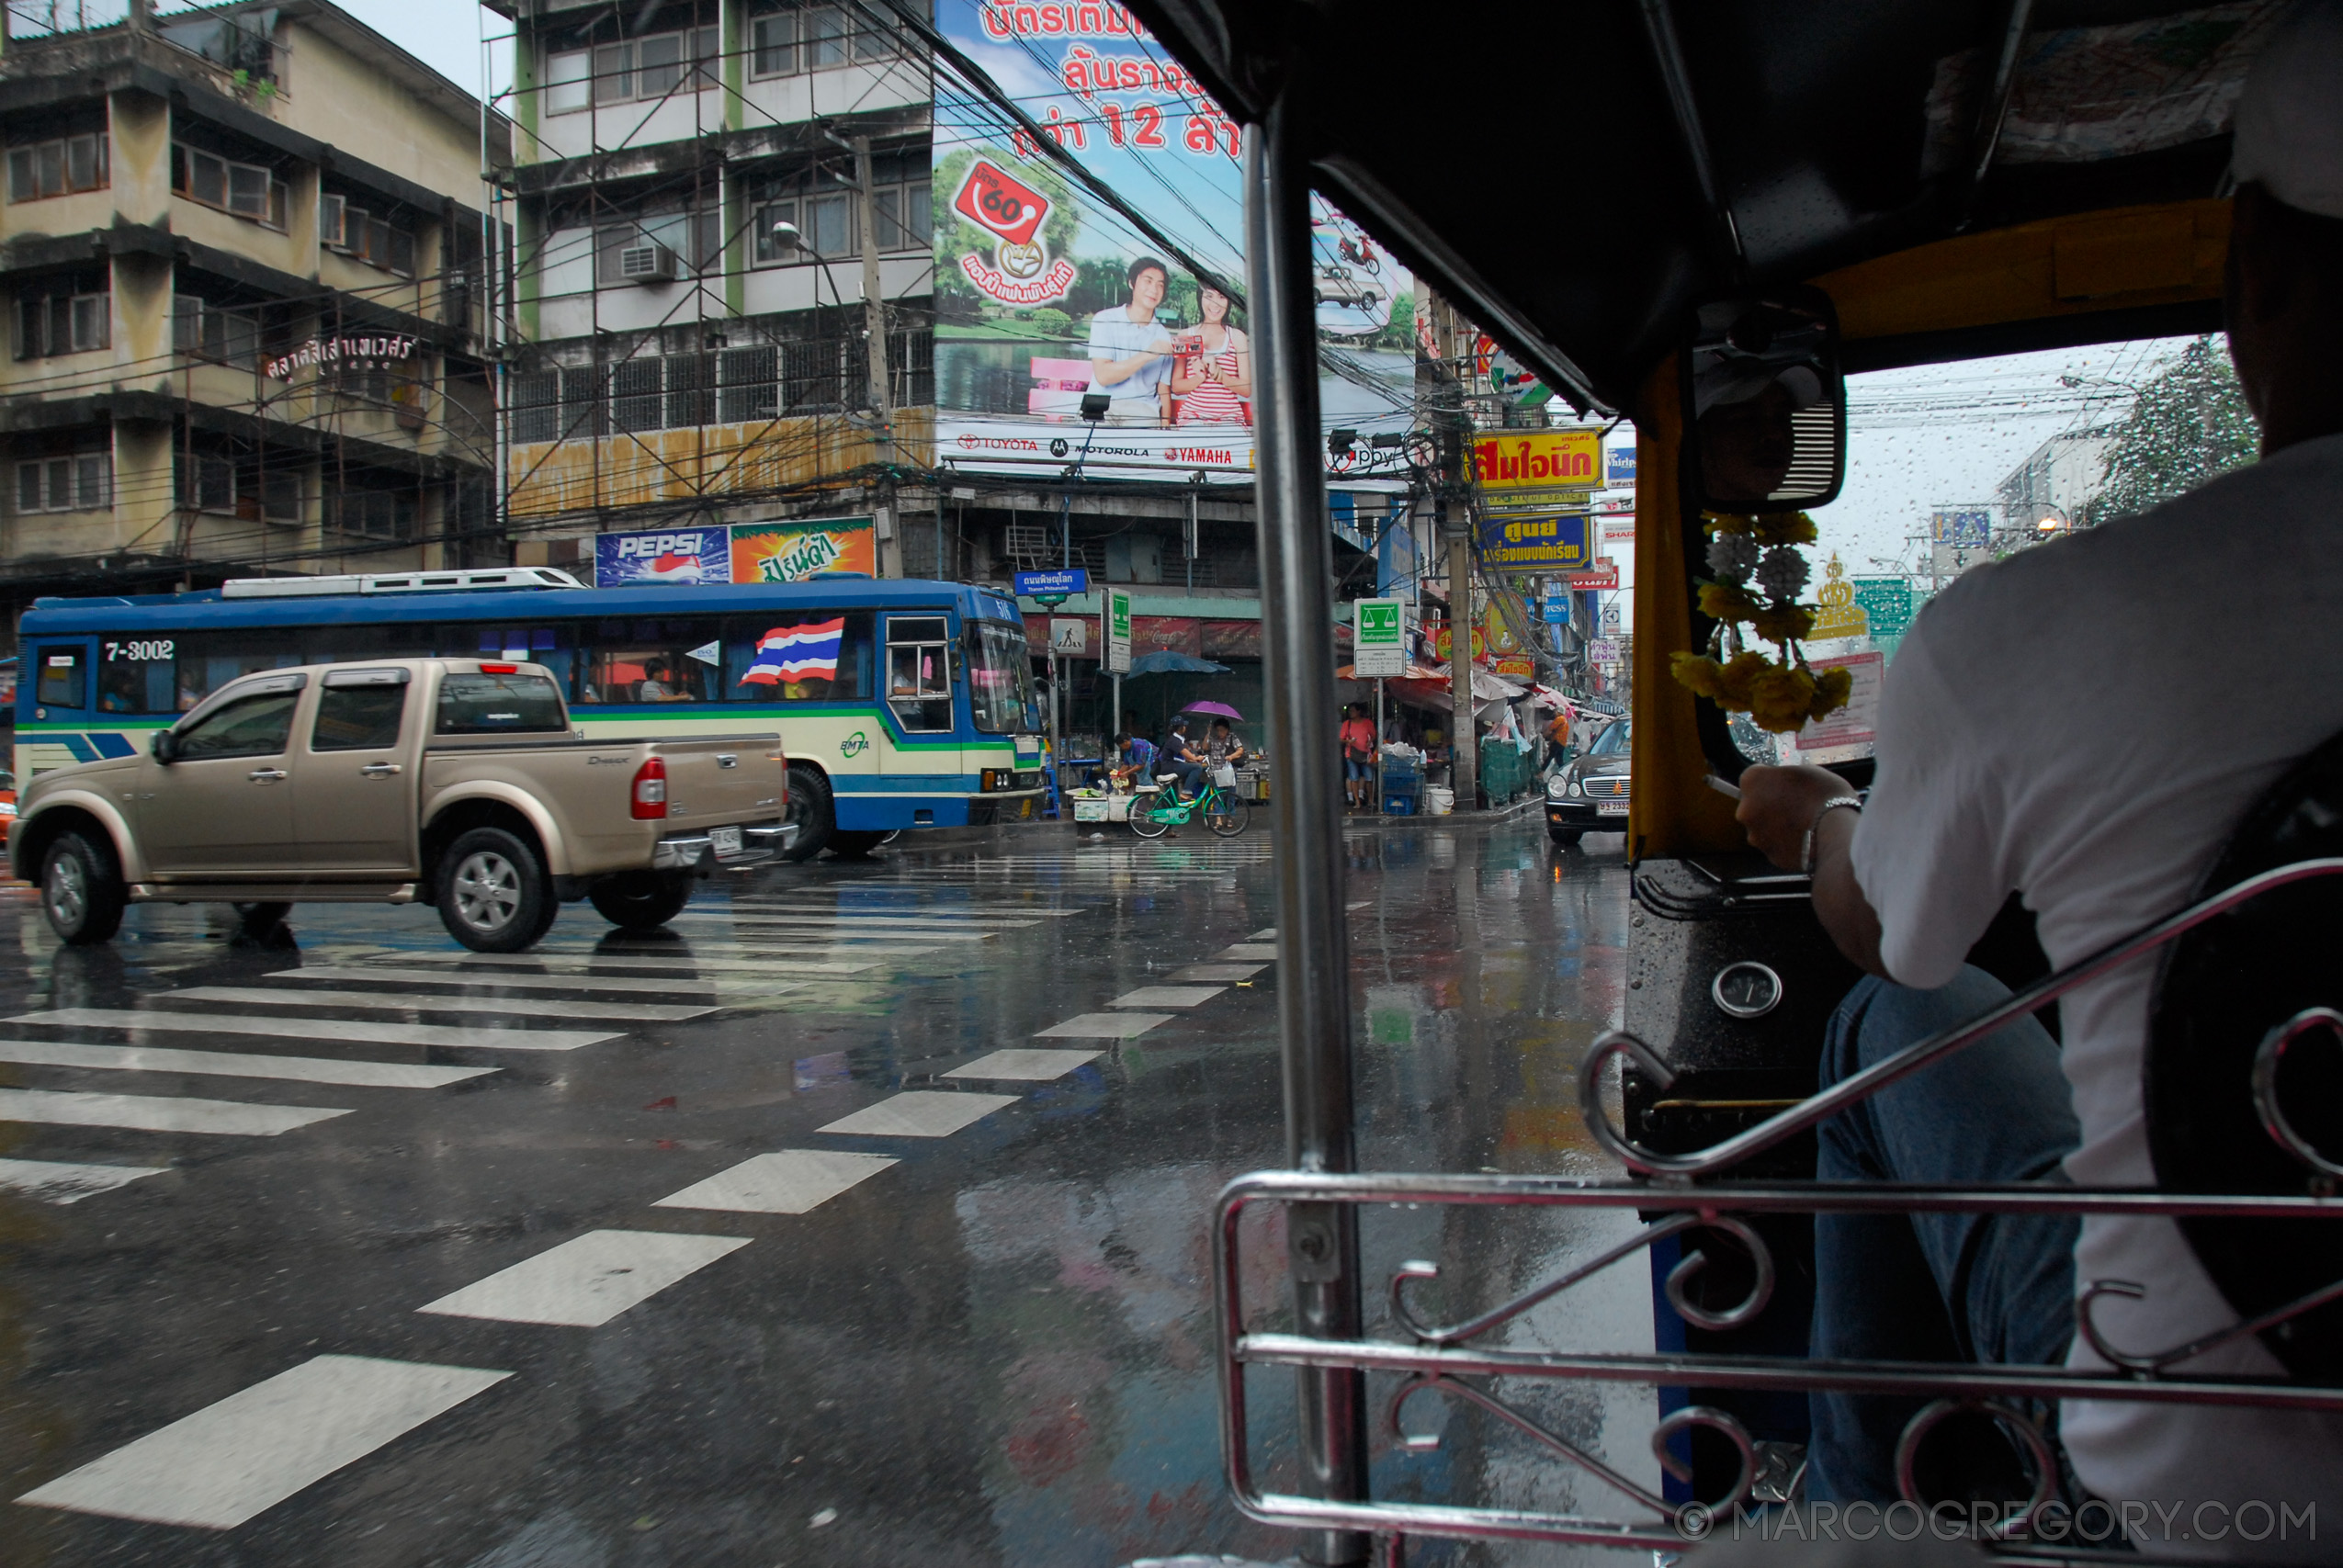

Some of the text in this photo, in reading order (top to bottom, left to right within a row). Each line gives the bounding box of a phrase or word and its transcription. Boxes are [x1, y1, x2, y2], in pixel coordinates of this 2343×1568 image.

[1102, 104, 1165, 147] 12
[974, 166, 1000, 189] บัตร
[982, 189, 1022, 221] 60
[983, 438, 1038, 451] TOYOTA
[1074, 445, 1149, 457] MOTOROLA
[1179, 447, 1232, 465] YAMAHA
[1473, 440, 1591, 481] สมใจนึก
[617, 533, 704, 559] PEPSI
[1483, 539, 1579, 563] เรื่องแบบนักเรียน
[1023, 571, 1073, 586] ถนนพิษณุโลก
[104, 639, 175, 662] 7-3002
[840, 740, 869, 750] BMTA
